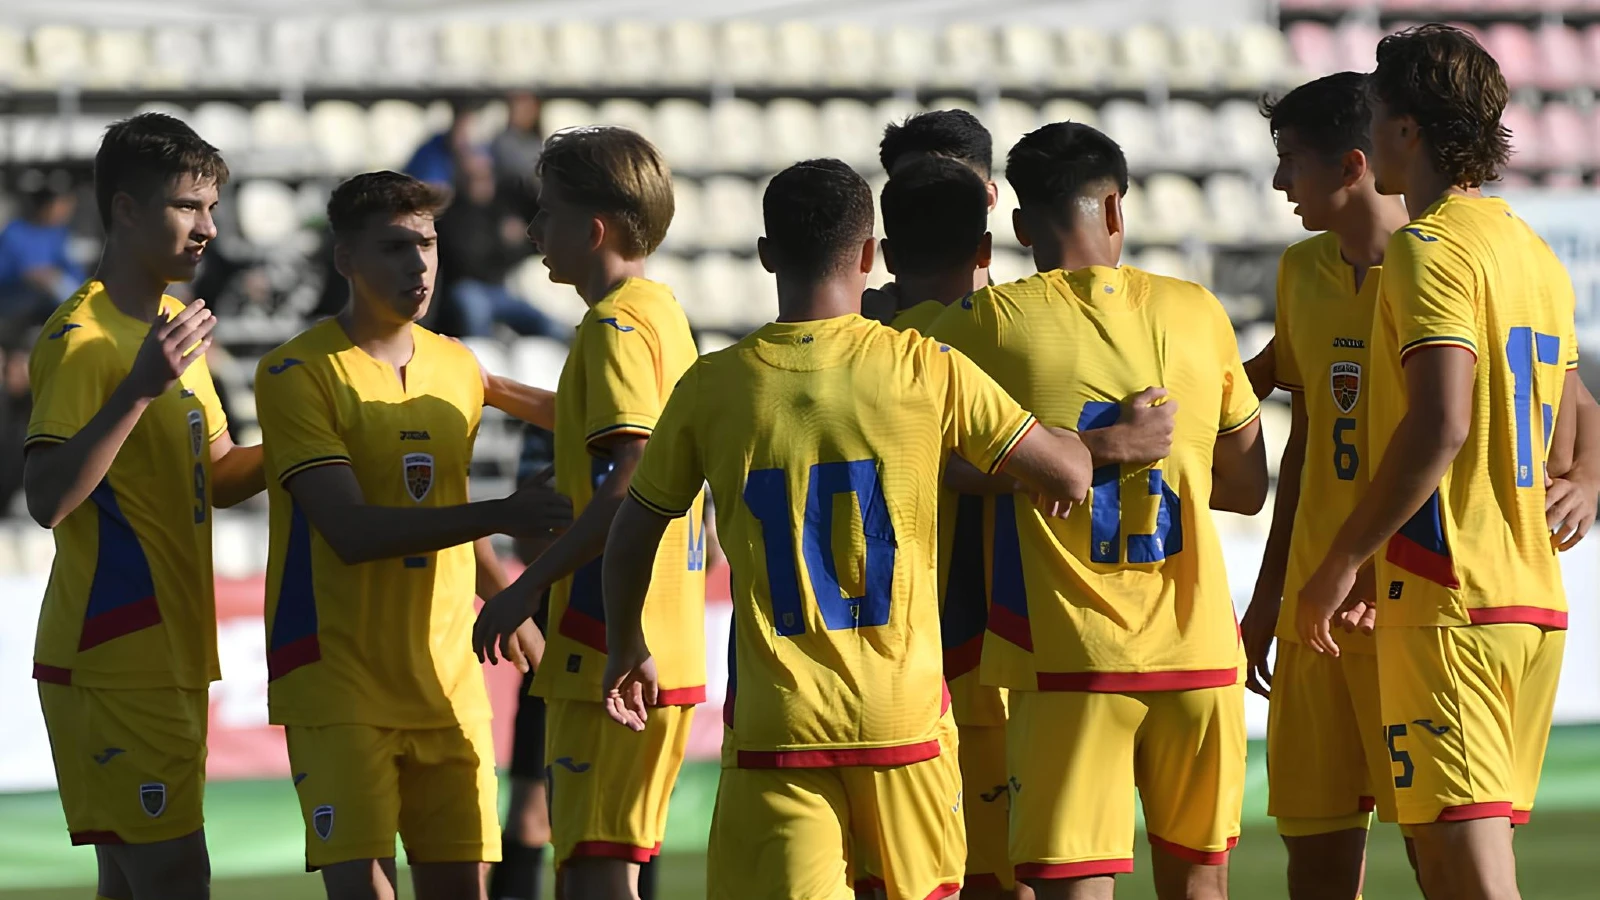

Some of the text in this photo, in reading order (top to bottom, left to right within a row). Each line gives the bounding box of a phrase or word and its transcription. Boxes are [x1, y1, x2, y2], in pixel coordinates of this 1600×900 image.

[1332, 417, 1360, 481] 6
[193, 461, 206, 524] 9
[742, 458, 898, 637] 10
[1383, 723, 1415, 789] 5
